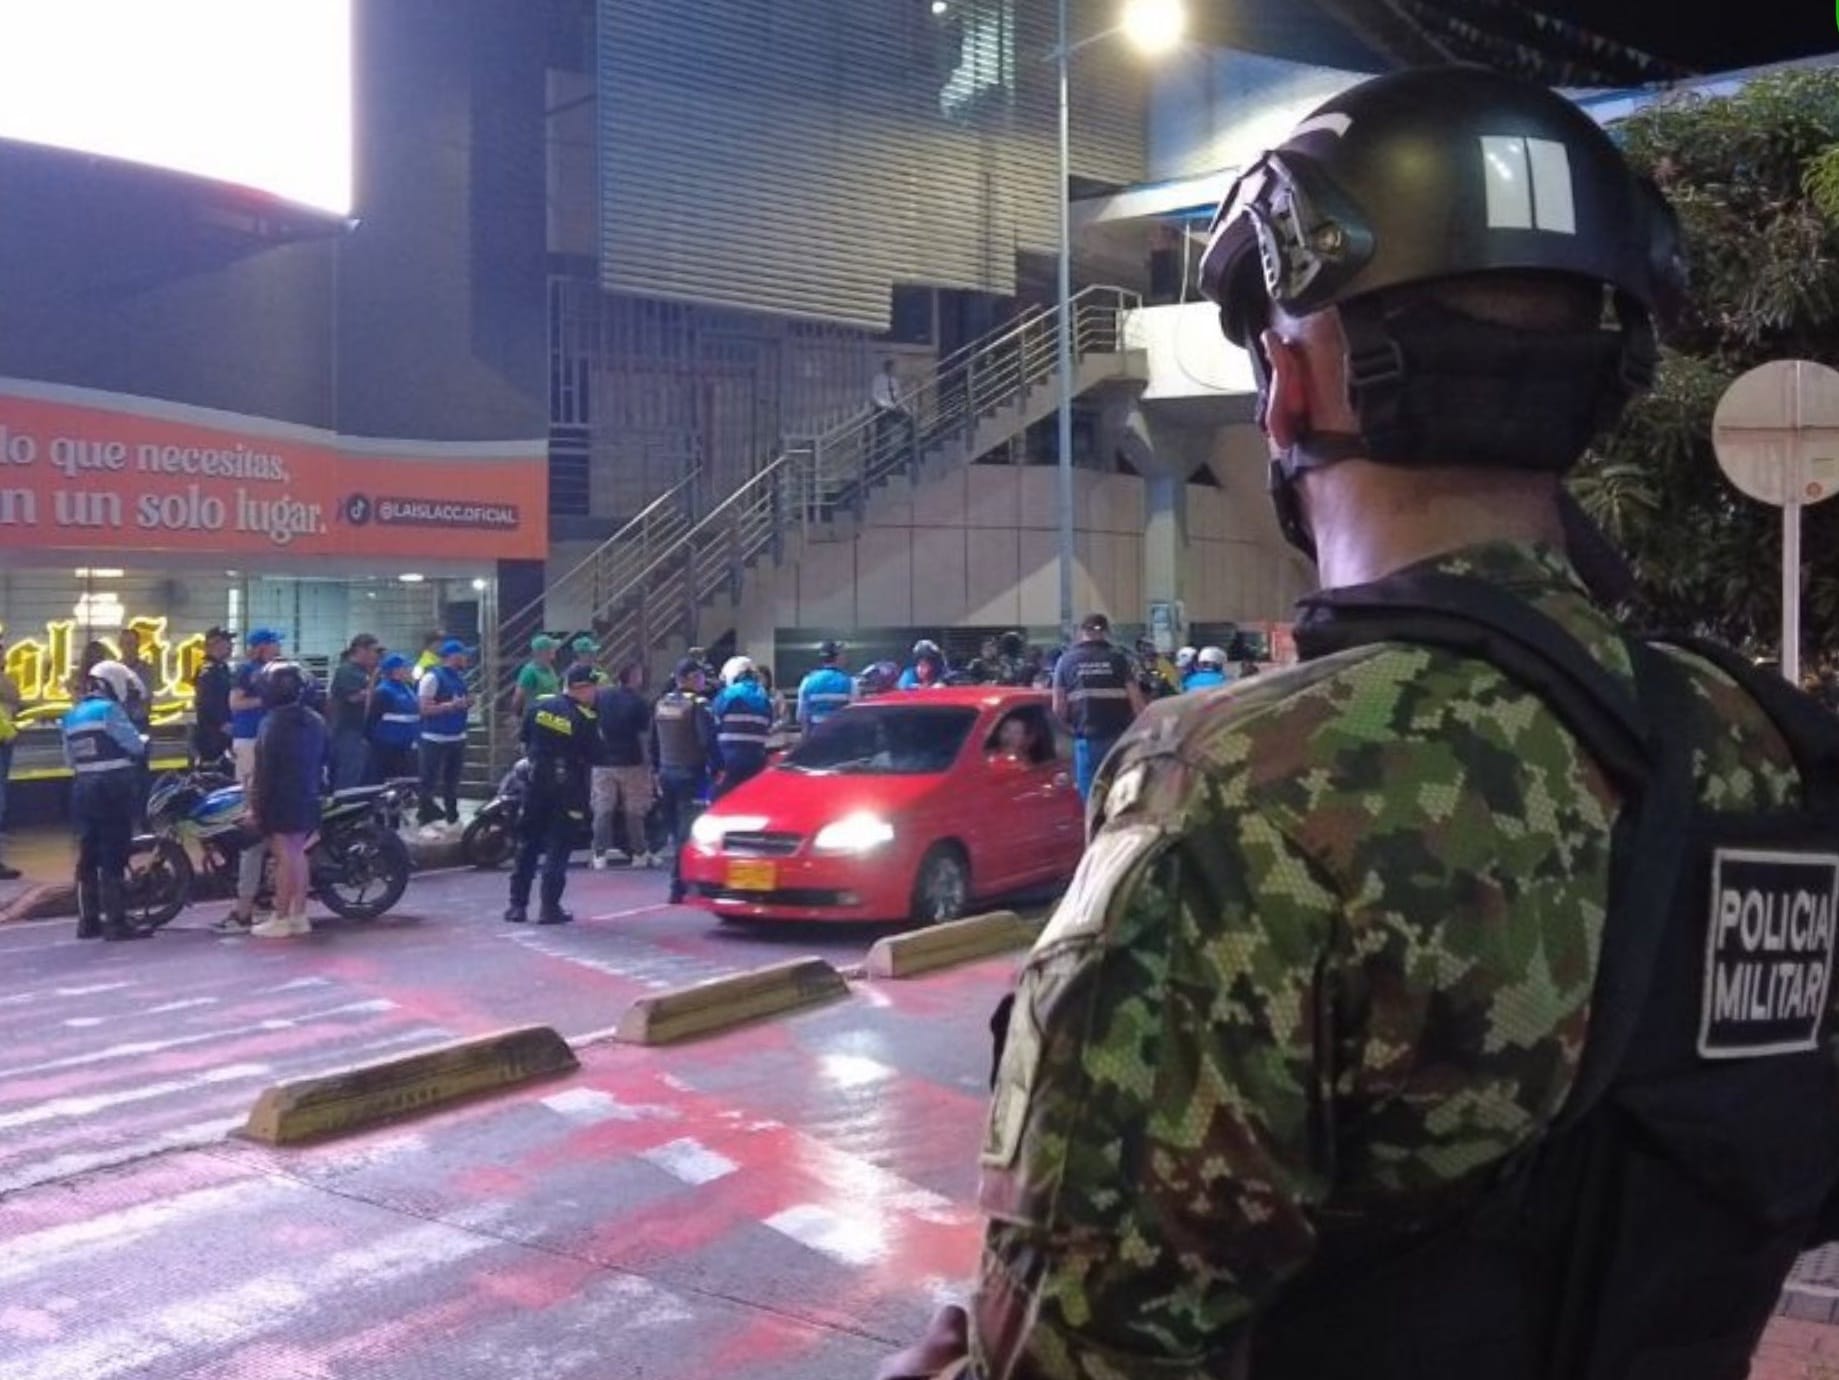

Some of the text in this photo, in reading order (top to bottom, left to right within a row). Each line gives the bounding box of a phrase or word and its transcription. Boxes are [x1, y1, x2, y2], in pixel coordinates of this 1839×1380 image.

[50, 437, 127, 478] que
[135, 442, 291, 484] necesitas,
[52, 489, 122, 528] un
[136, 483, 225, 530] solo
[235, 487, 328, 544] lugar.
[1718, 889, 1829, 951] POLICIA
[1714, 961, 1824, 1022] MILITAR
